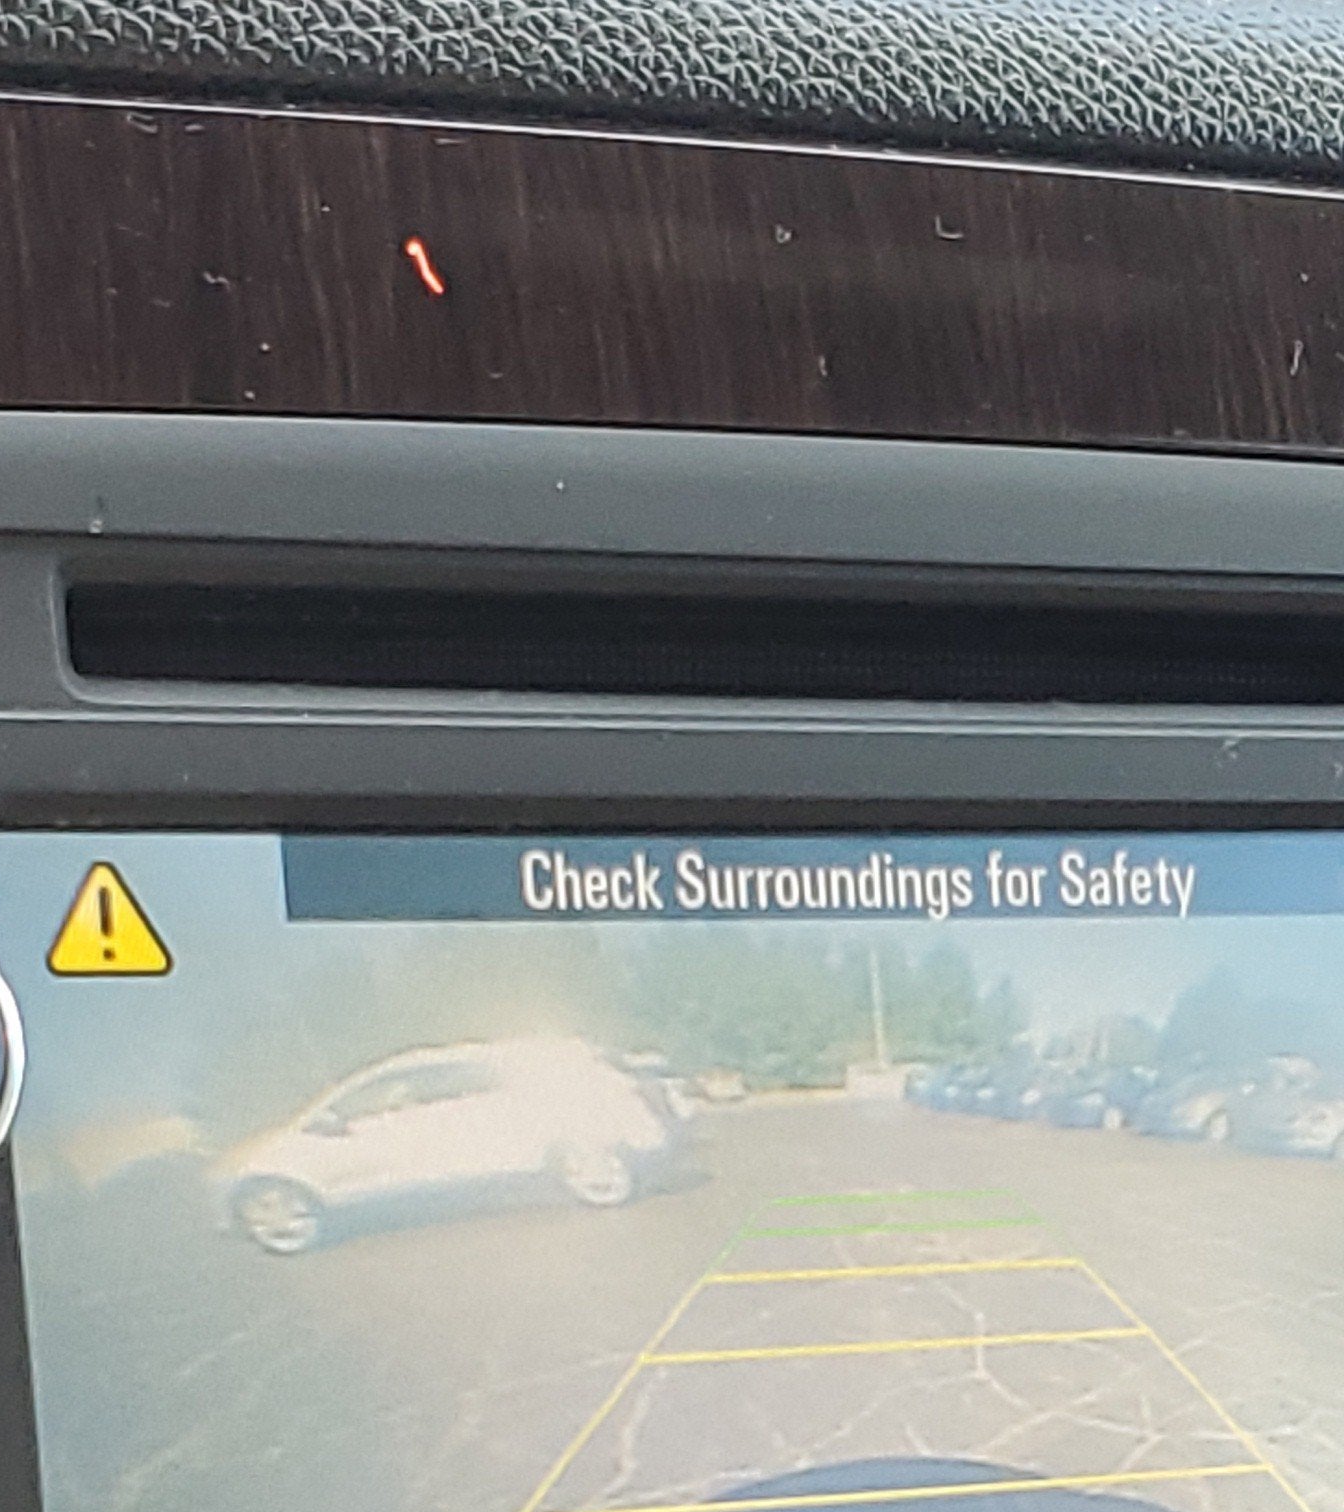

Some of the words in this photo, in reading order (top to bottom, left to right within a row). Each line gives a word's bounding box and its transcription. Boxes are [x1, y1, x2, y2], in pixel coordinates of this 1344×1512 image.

[521, 850, 664, 911] Check
[675, 850, 973, 920] Surroundings
[986, 850, 1048, 907] for
[1060, 850, 1195, 919] Safety
